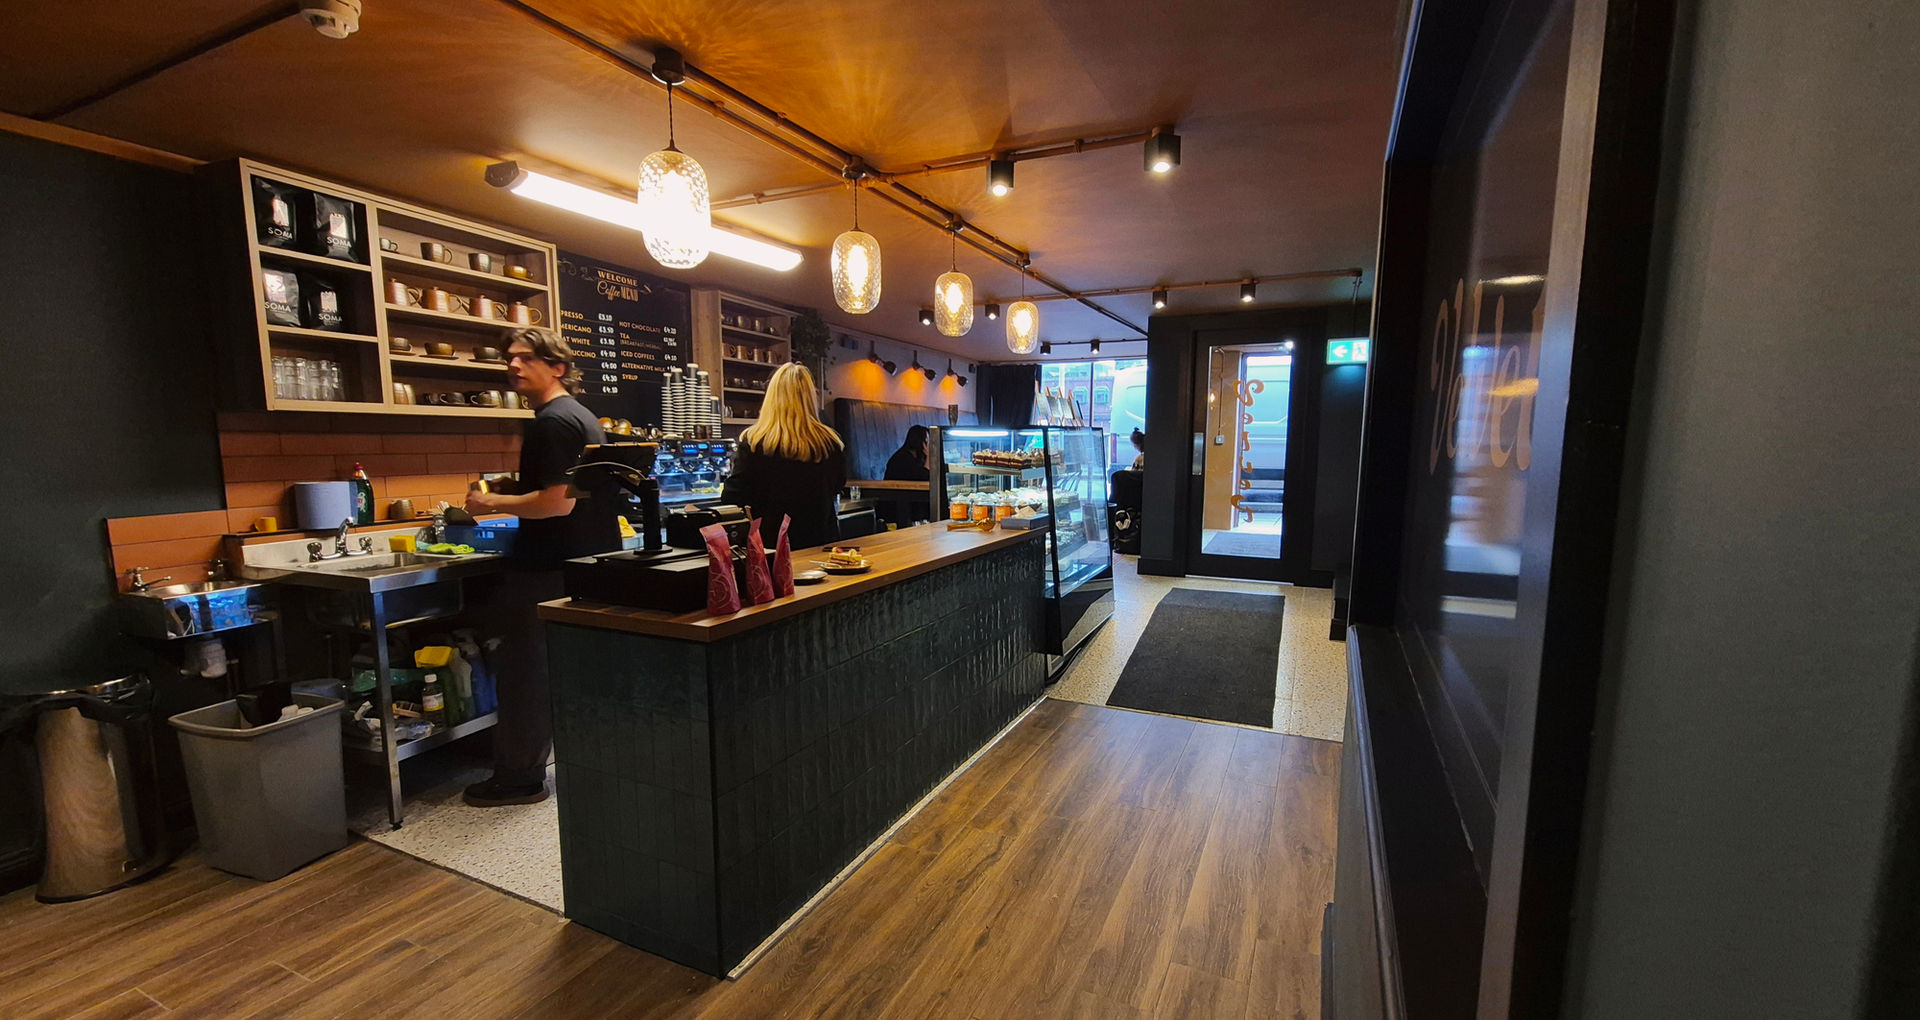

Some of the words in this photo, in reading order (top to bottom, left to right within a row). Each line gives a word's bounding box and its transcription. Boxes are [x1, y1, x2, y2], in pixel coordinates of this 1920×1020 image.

[268, 227, 293, 240] SOMA
[327, 236, 352, 248] SOMA
[597, 271, 638, 287] WELCOME
[597, 280, 621, 301] Coffee
[620, 286, 638, 302] MENU
[264, 301, 291, 313] SOMA
[318, 313, 342, 322] SOMA
[561, 310, 583, 320] PRESSO
[561, 324, 592, 333] MERICANO
[571, 337, 590, 346] WHITE
[621, 350, 633, 358] ICED
[634, 352, 655, 360] COFFEES
[621, 362, 653, 371] ALTERNATIVE
